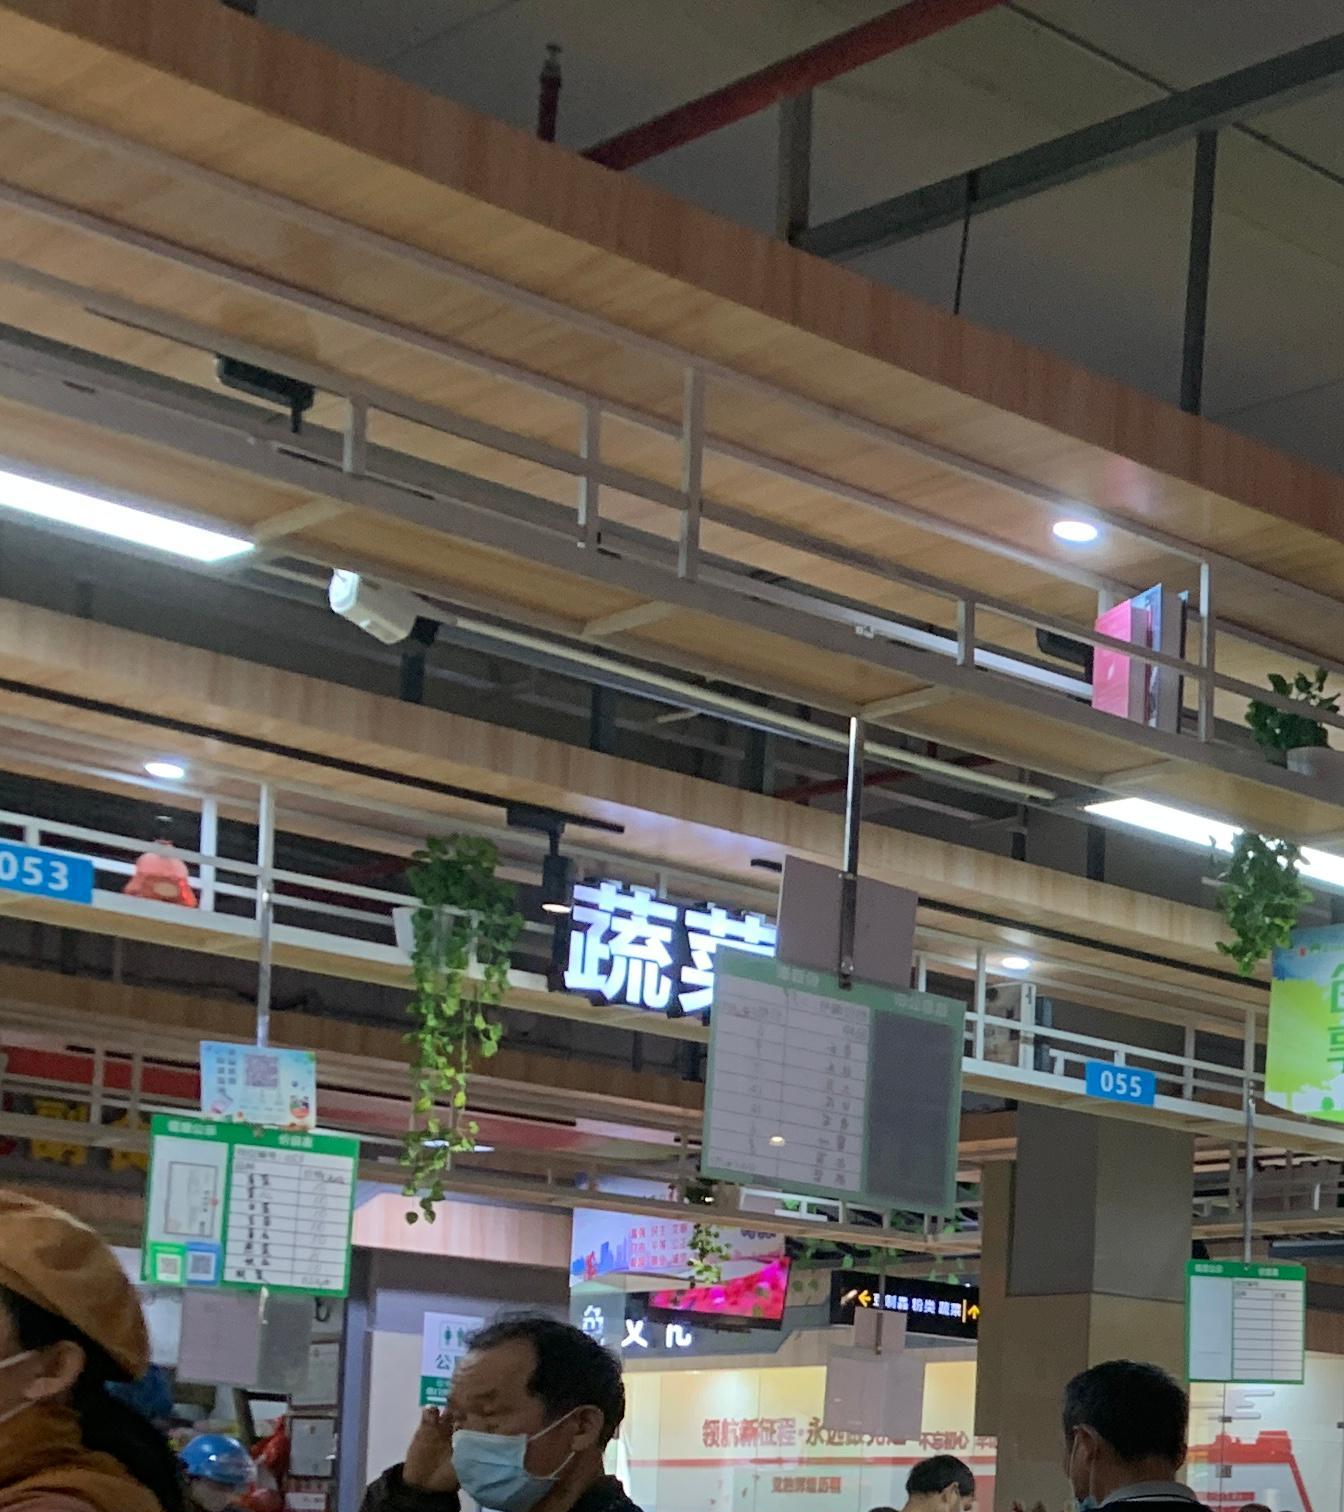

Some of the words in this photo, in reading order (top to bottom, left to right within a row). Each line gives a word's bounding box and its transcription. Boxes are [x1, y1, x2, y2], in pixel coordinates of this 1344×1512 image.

[0, 851, 69, 892] 053
[563, 880, 778, 1013] 蔬菜
[1099, 1069, 1143, 1099] 055
